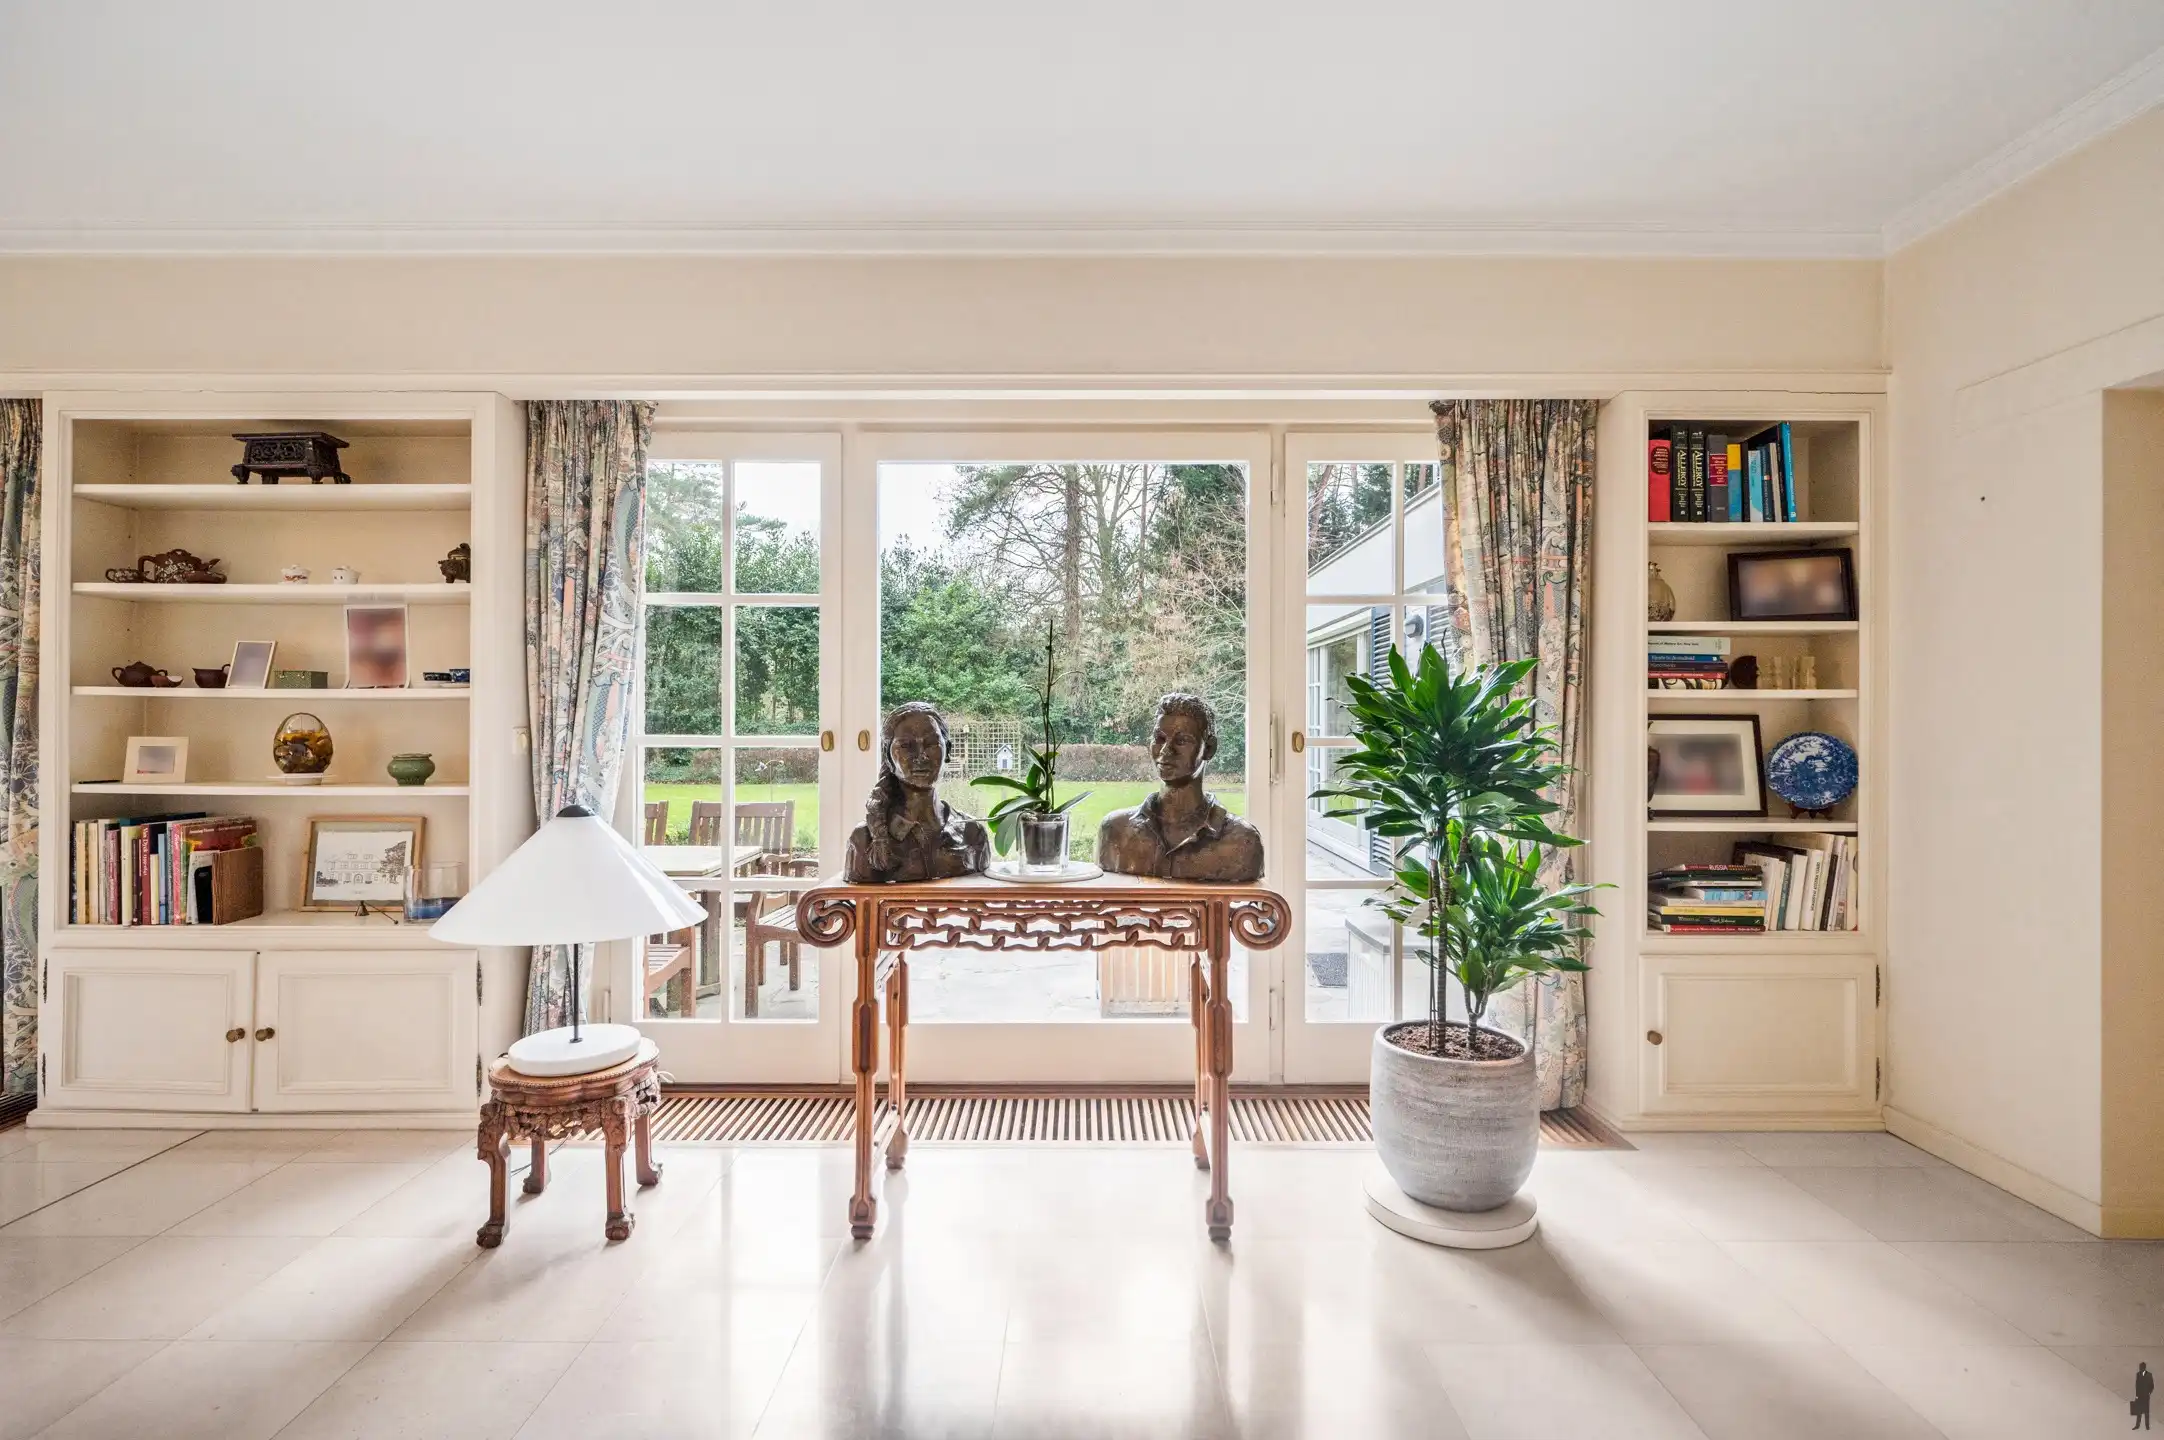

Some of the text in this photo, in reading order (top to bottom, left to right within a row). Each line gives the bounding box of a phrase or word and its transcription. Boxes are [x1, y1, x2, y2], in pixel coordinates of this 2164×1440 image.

[1679, 449, 1687, 488] ALLERGY
[1695, 449, 1704, 488] ALLERGY
[141, 839, 149, 853] Dyck
